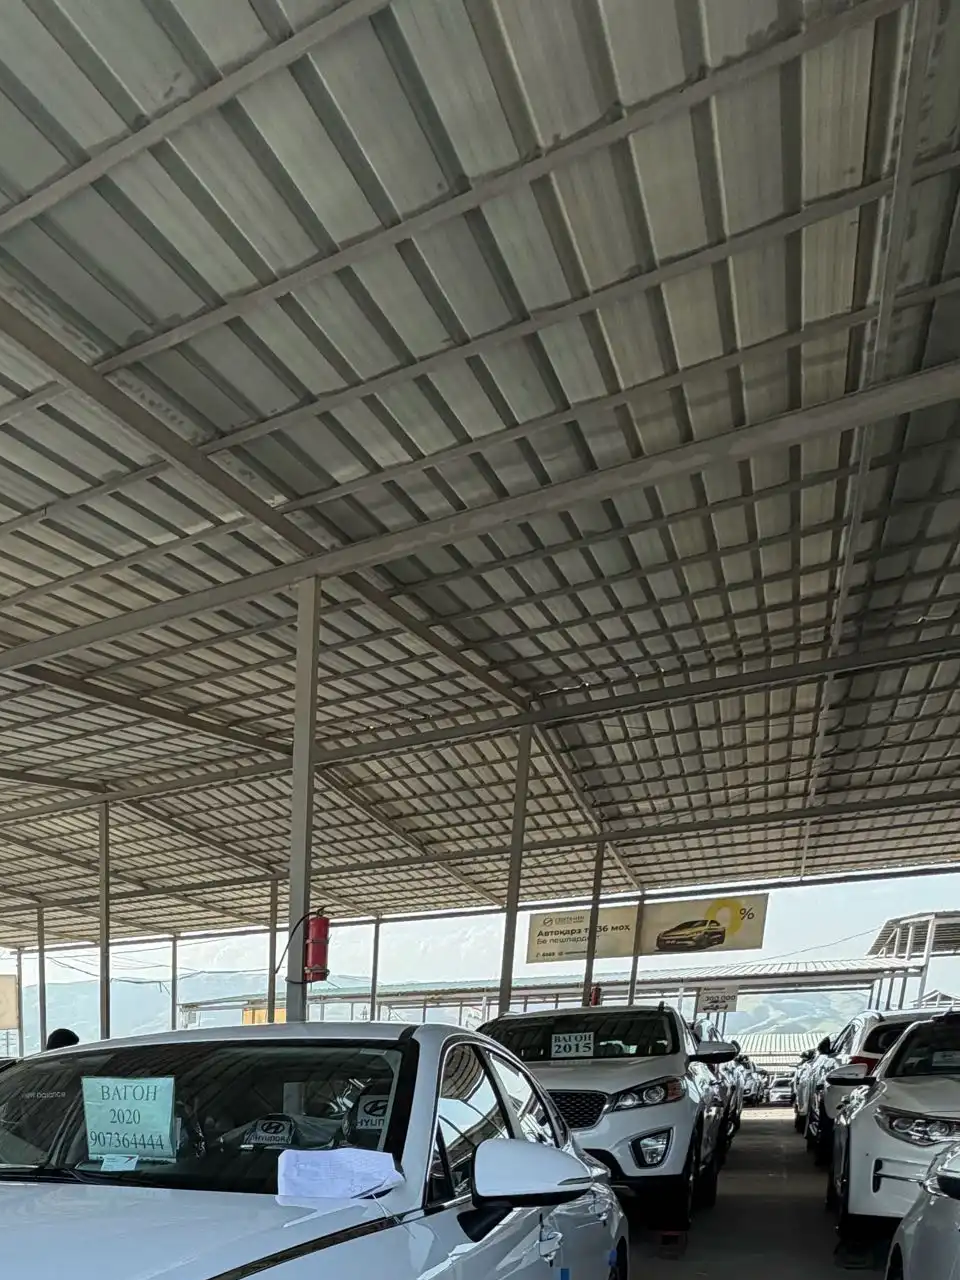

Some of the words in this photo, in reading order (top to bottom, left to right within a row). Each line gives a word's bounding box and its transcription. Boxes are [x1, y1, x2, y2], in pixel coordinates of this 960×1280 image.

[537, 928, 582, 938] Автоқарз
[596, 924, 609, 932] 36
[553, 1033, 592, 1043] ВАГОН
[554, 1042, 592, 1054] 2015
[101, 1084, 158, 1101] ВАГОН
[109, 1108, 141, 1125] 2020
[89, 1130, 165, 1150] 907364444
